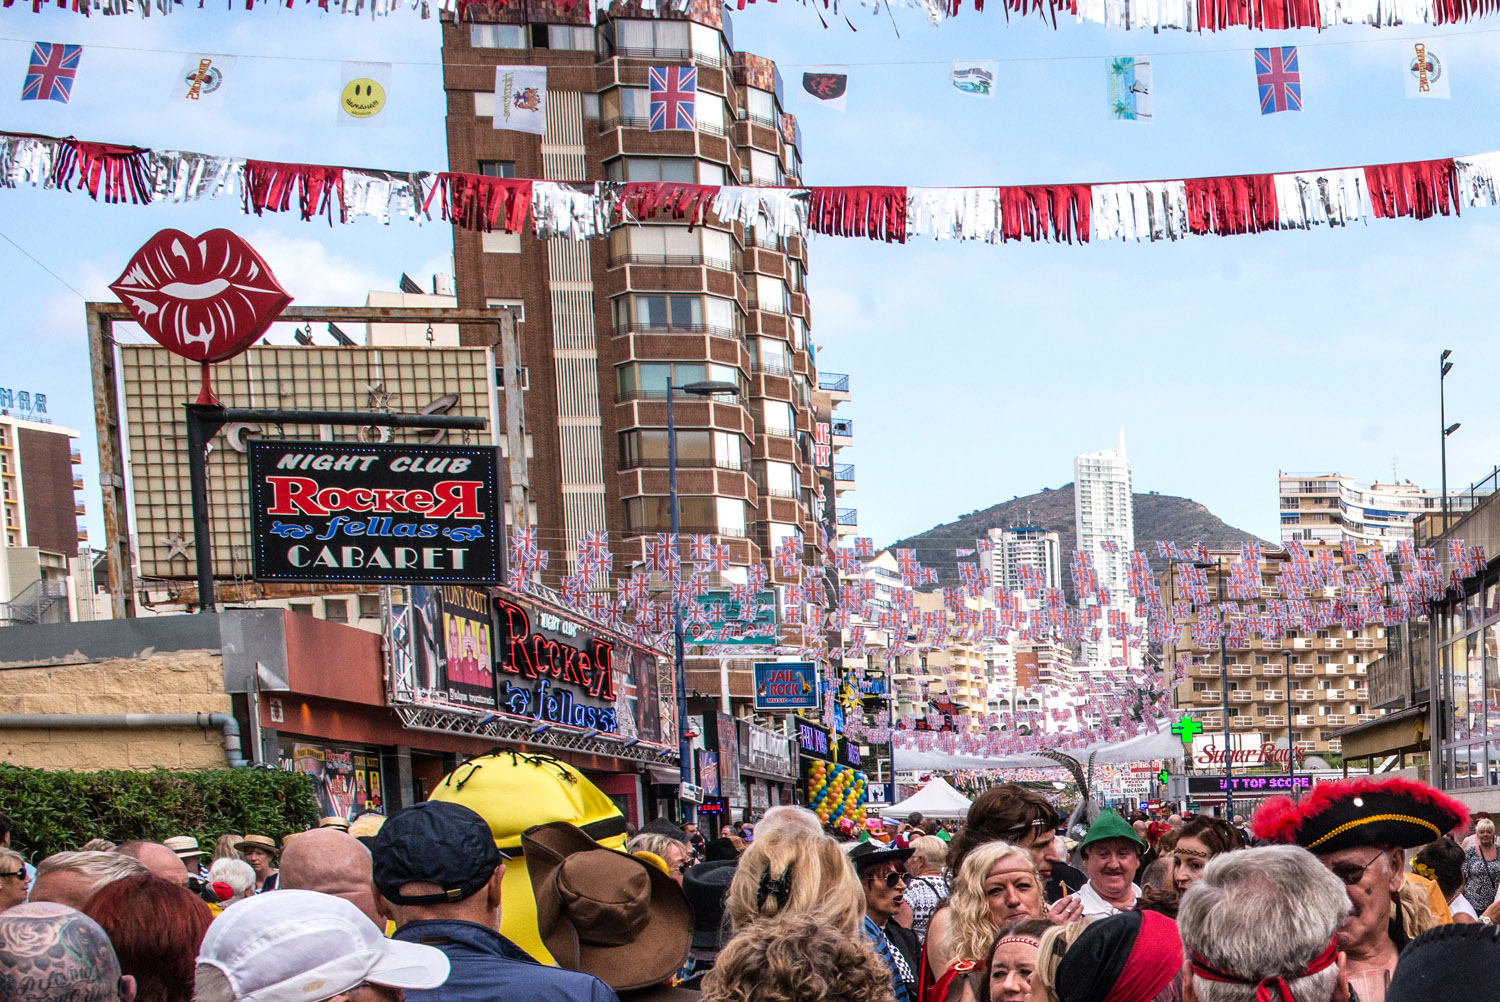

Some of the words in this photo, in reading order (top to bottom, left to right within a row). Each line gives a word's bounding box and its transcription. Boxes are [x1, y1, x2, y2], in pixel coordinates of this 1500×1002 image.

[277, 453, 379, 472] NIGHT
[389, 456, 472, 474] CLUB
[316, 515, 439, 540] fellas
[287, 544, 469, 570] CABARET
[466, 588, 488, 615] SCOTT
[768, 669, 797, 682] JAIL
[769, 683, 800, 696] ROCK
[532, 679, 601, 728] fellas
[1242, 778, 1266, 789] TOP
